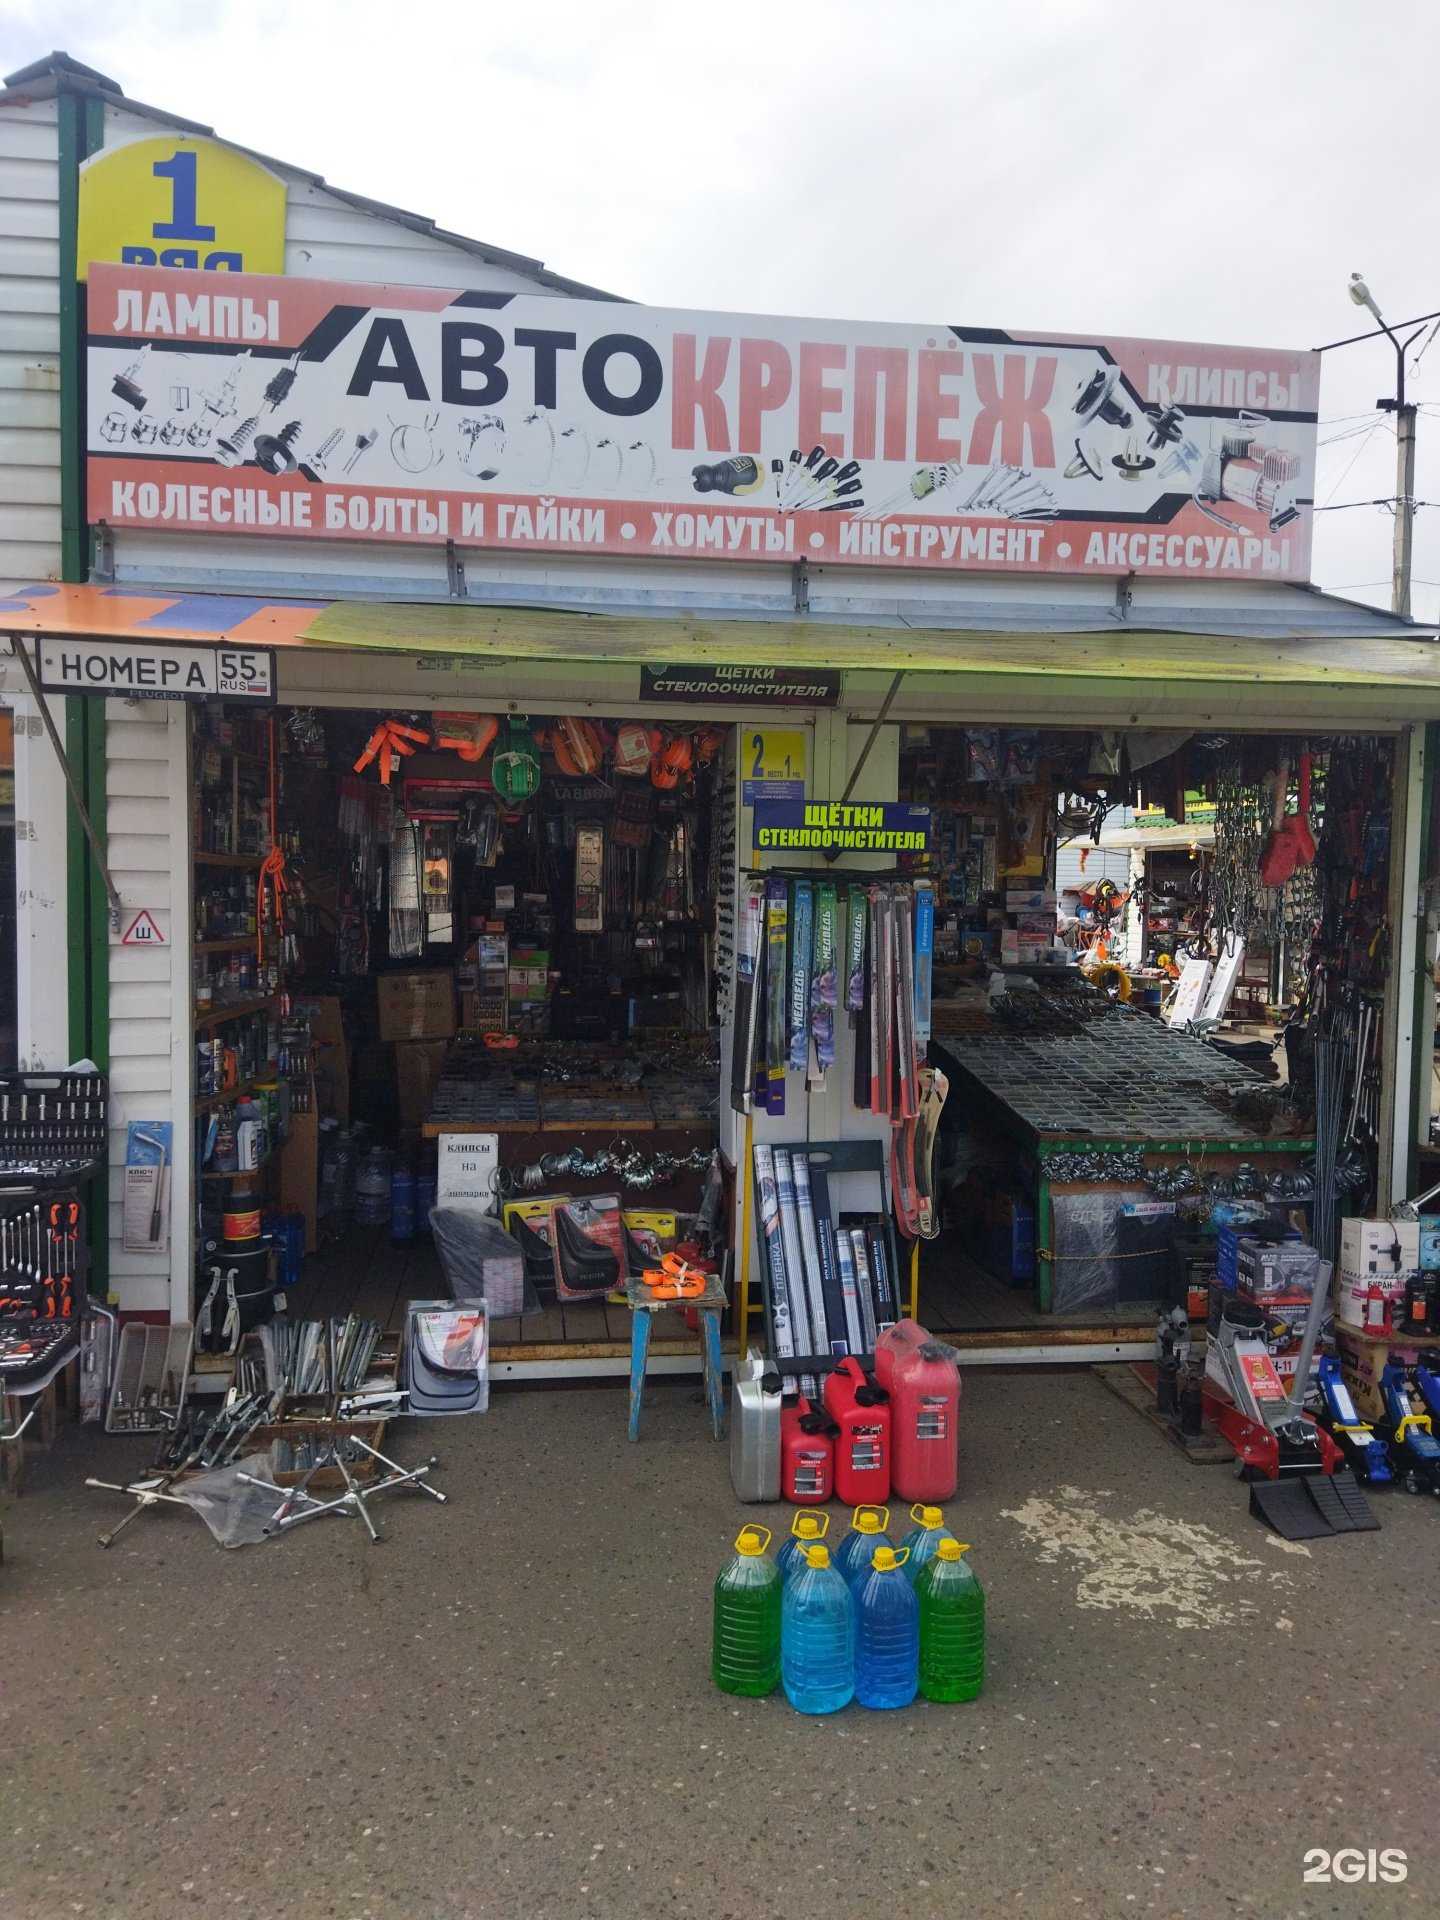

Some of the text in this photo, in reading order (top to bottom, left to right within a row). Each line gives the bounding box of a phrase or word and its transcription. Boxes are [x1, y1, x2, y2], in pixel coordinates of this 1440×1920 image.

[152, 151, 217, 242] 1
[113, 289, 280, 341] ЛАМПЫ
[1148, 363, 1300, 410] КЛИПСЫ
[112, 480, 1291, 571] КОЛЕСНЫЕ БОЛТЫ И ГАЙКИ ХОМУТЫ ИНСТРУМЕНТ АКСЕССУАРЫ
[61, 653, 207, 688] НОМЕРА
[220, 654, 257, 681] 55
[220, 680, 247, 691] RUS
[653, 680, 828, 697] СТЕКЛООЧИСТИТЕЛЯ
[715, 666, 775, 679] ЩЕТКИ
[129, 690, 185, 700] PEUGEOT
[751, 734, 764, 777] 2
[784, 754, 791, 778] 1
[804, 802, 884, 829] ЩЁТКИ
[758, 828, 926, 850] СТЕКЛООЧИСТИТЕЛЯ
[821, 910, 832, 960] МЕДВЕДЬ
[853, 912, 864, 962] МЕДВЕДЬ
[792, 969, 806, 1027] МЕДВЕДЬ
[771, 1241, 785, 1290] ПЛЕНКА
